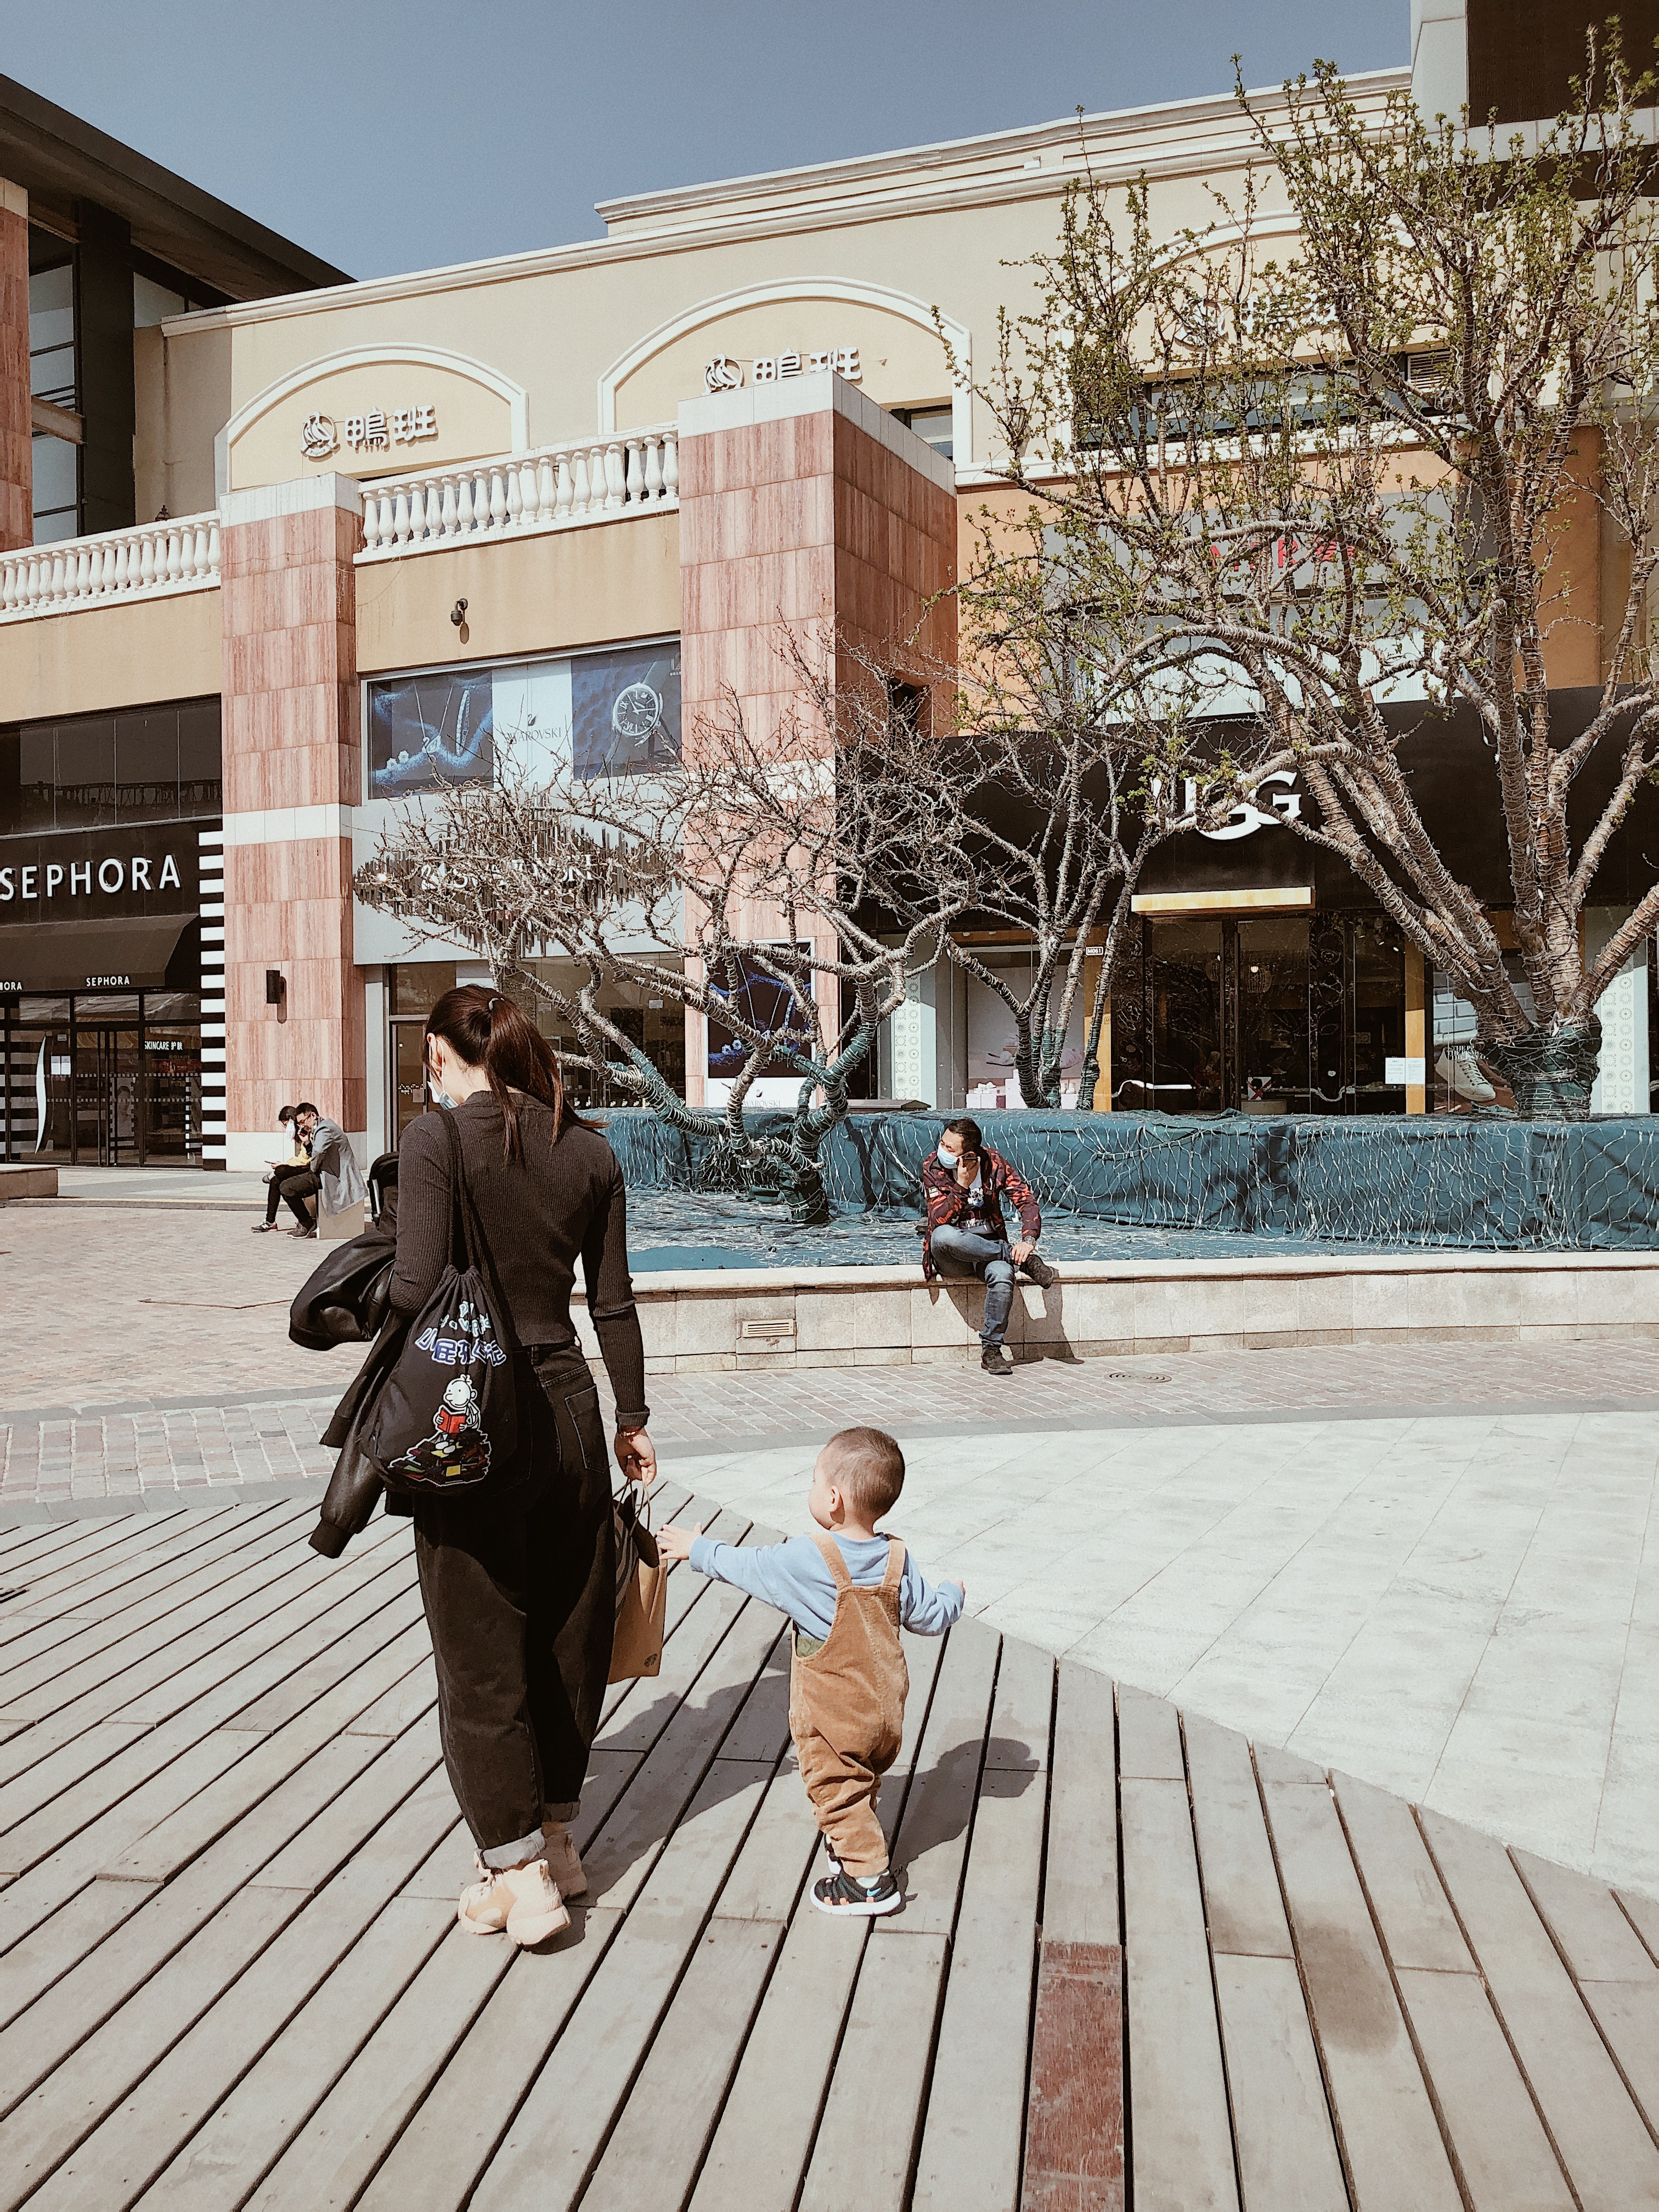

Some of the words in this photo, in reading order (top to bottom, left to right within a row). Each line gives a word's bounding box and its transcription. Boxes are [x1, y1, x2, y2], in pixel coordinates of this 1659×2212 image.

[0, 854, 181, 901] SEPHORA
[86, 975, 130, 987] SEPHORA
[144, 1041, 169, 1050] SKINCARE
[171, 1041, 183, 1050] 护肤
